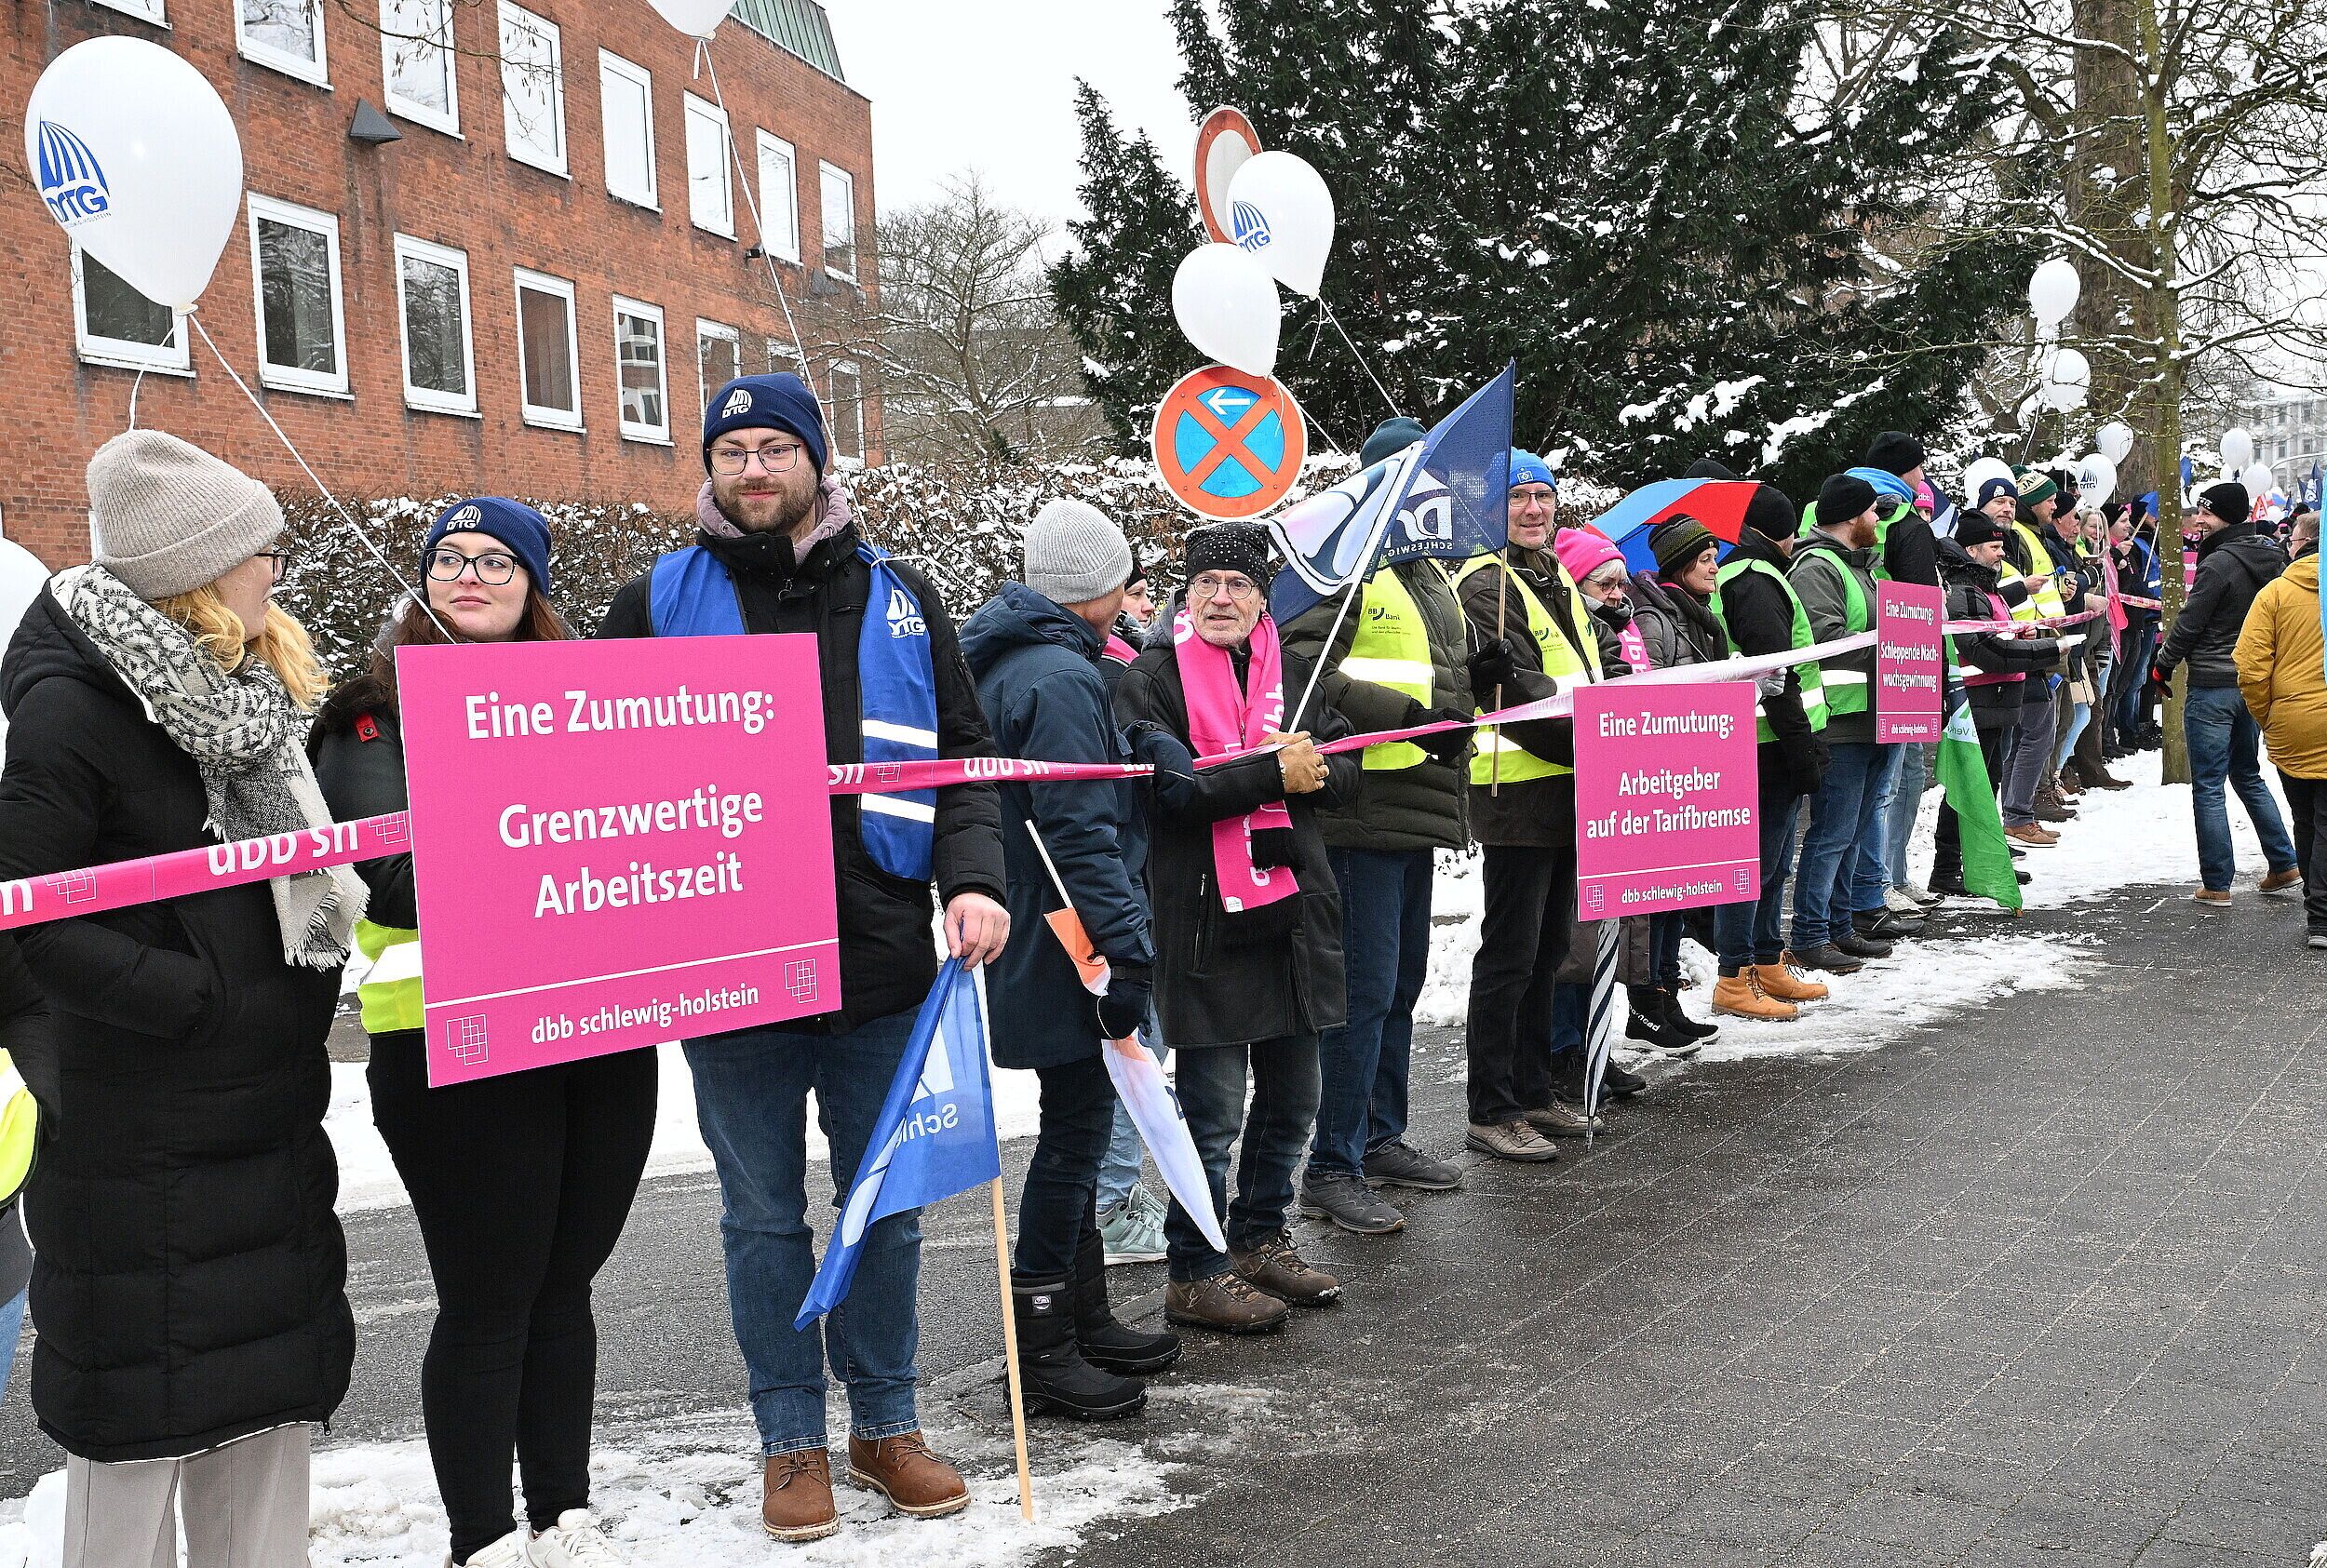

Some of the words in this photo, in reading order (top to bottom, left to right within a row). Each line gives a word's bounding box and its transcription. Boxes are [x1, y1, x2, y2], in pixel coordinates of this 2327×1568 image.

[1885, 598, 1899, 618] Eine
[1900, 600, 1934, 626] Zumutung:
[1880, 640, 1920, 665] Schleppende
[1882, 668, 1937, 693] wuchsgewinnung
[465, 691, 554, 740] Eine
[564, 684, 775, 735] Zumutung:
[1599, 711, 1637, 738] Eine
[1640, 709, 1735, 740] Zumutung:
[1618, 766, 1721, 801] Arbeitgeber
[499, 784, 763, 849] Grenzwertige
[1586, 810, 1618, 839] auf
[1621, 809, 1650, 837] der
[1652, 804, 1751, 833] Tarifbremse
[533, 851, 744, 919] Arbeitszeit
[1621, 889, 1640, 904] dbb
[1642, 878, 1723, 902] schlewig-holstein
[531, 1011, 574, 1045] dbb
[579, 982, 760, 1034] schlewig-holstein
